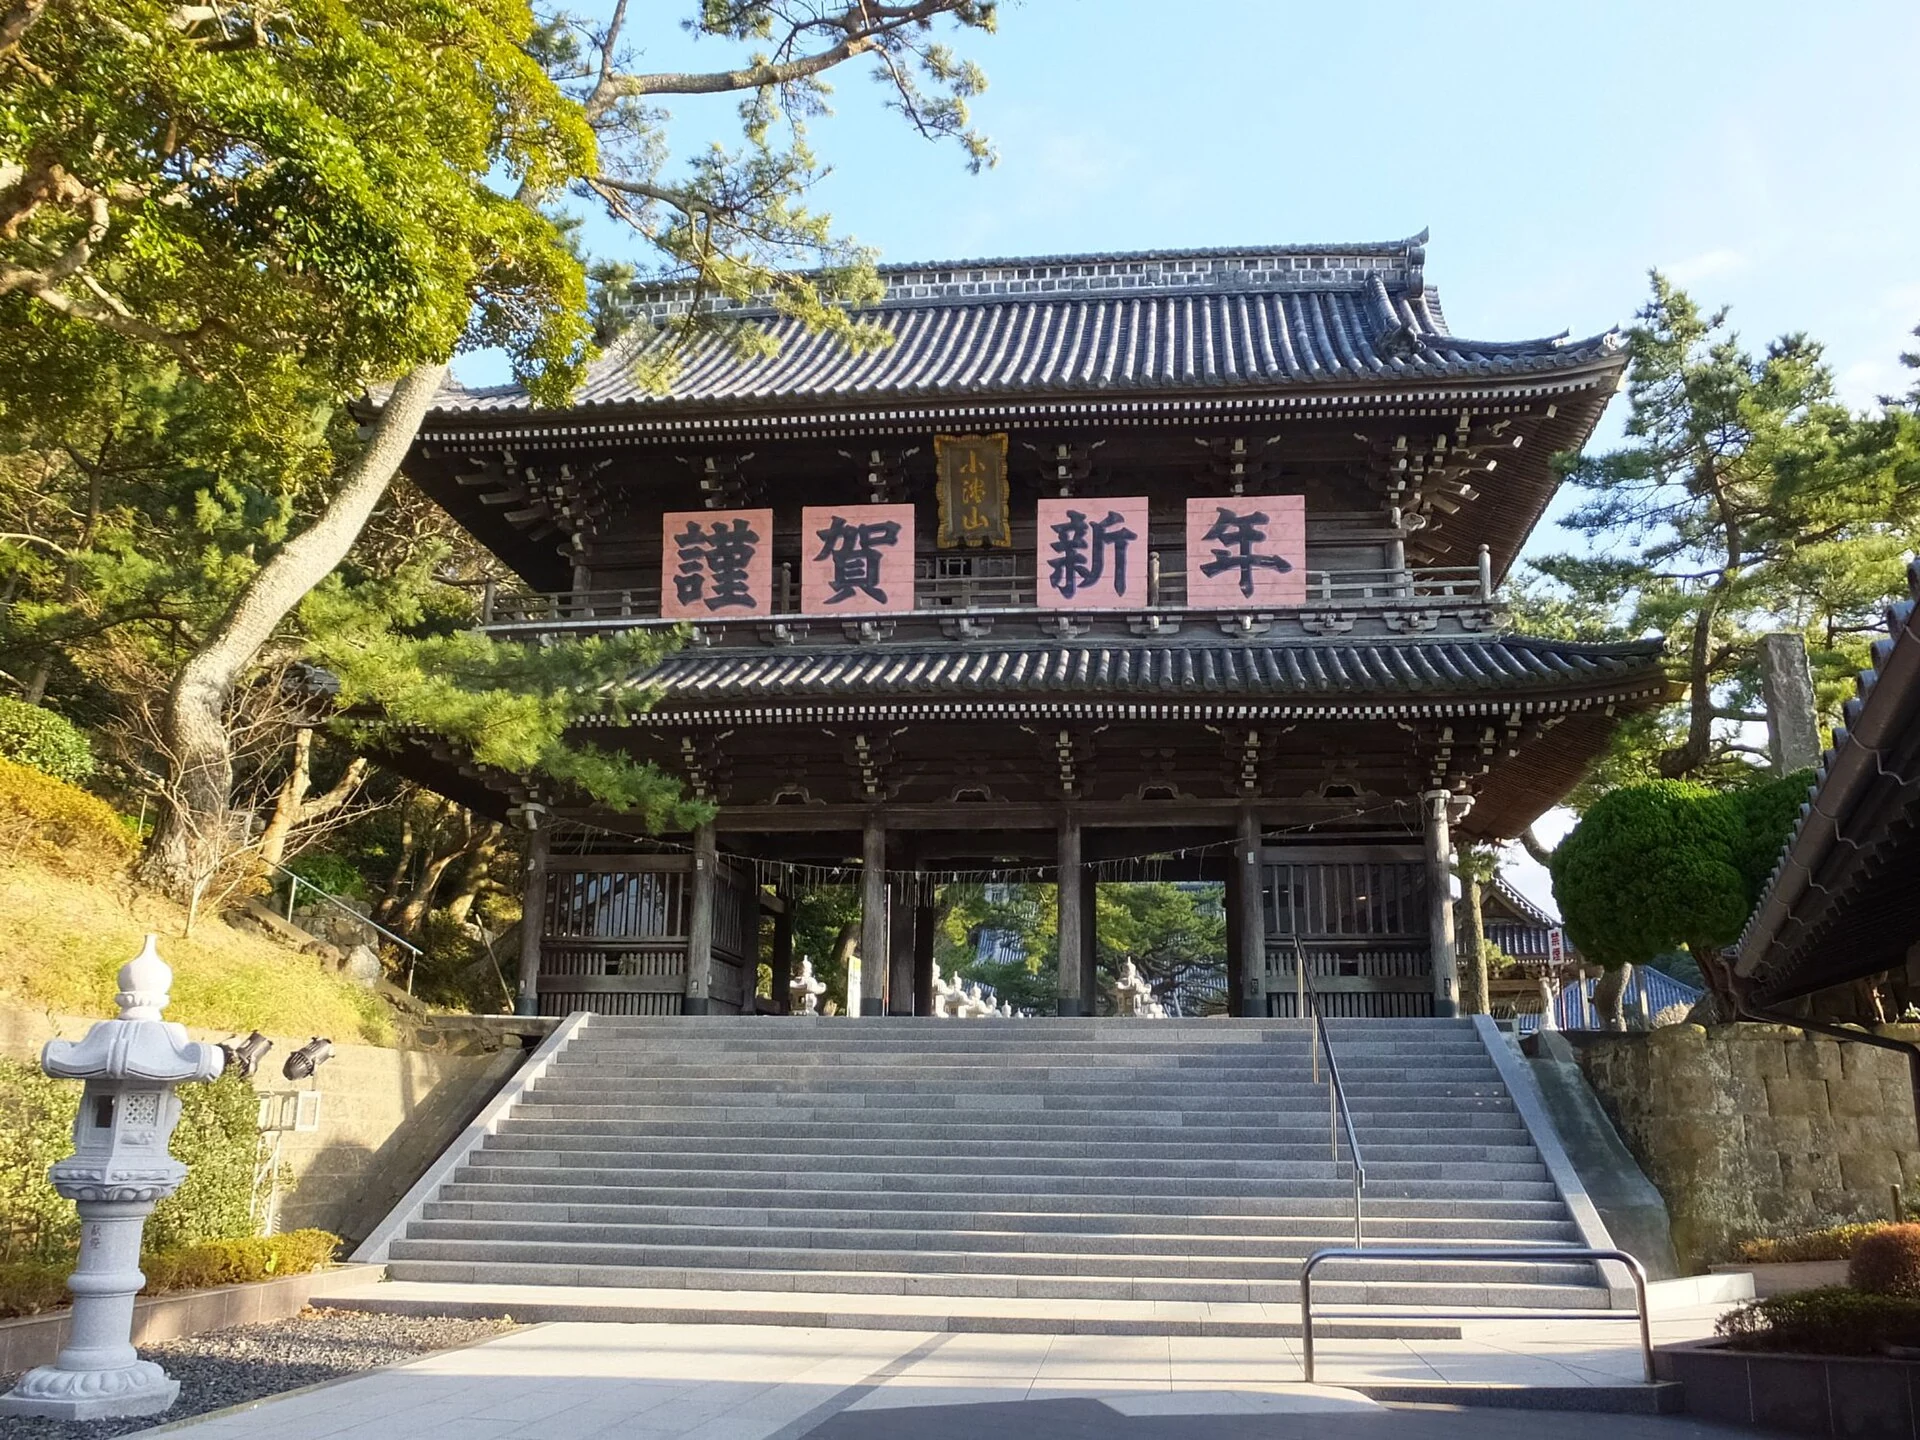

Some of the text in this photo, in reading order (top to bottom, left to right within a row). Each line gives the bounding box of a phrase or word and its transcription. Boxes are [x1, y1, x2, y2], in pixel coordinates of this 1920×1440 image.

[673, 506, 1292, 612] 謹 賀 新 年
